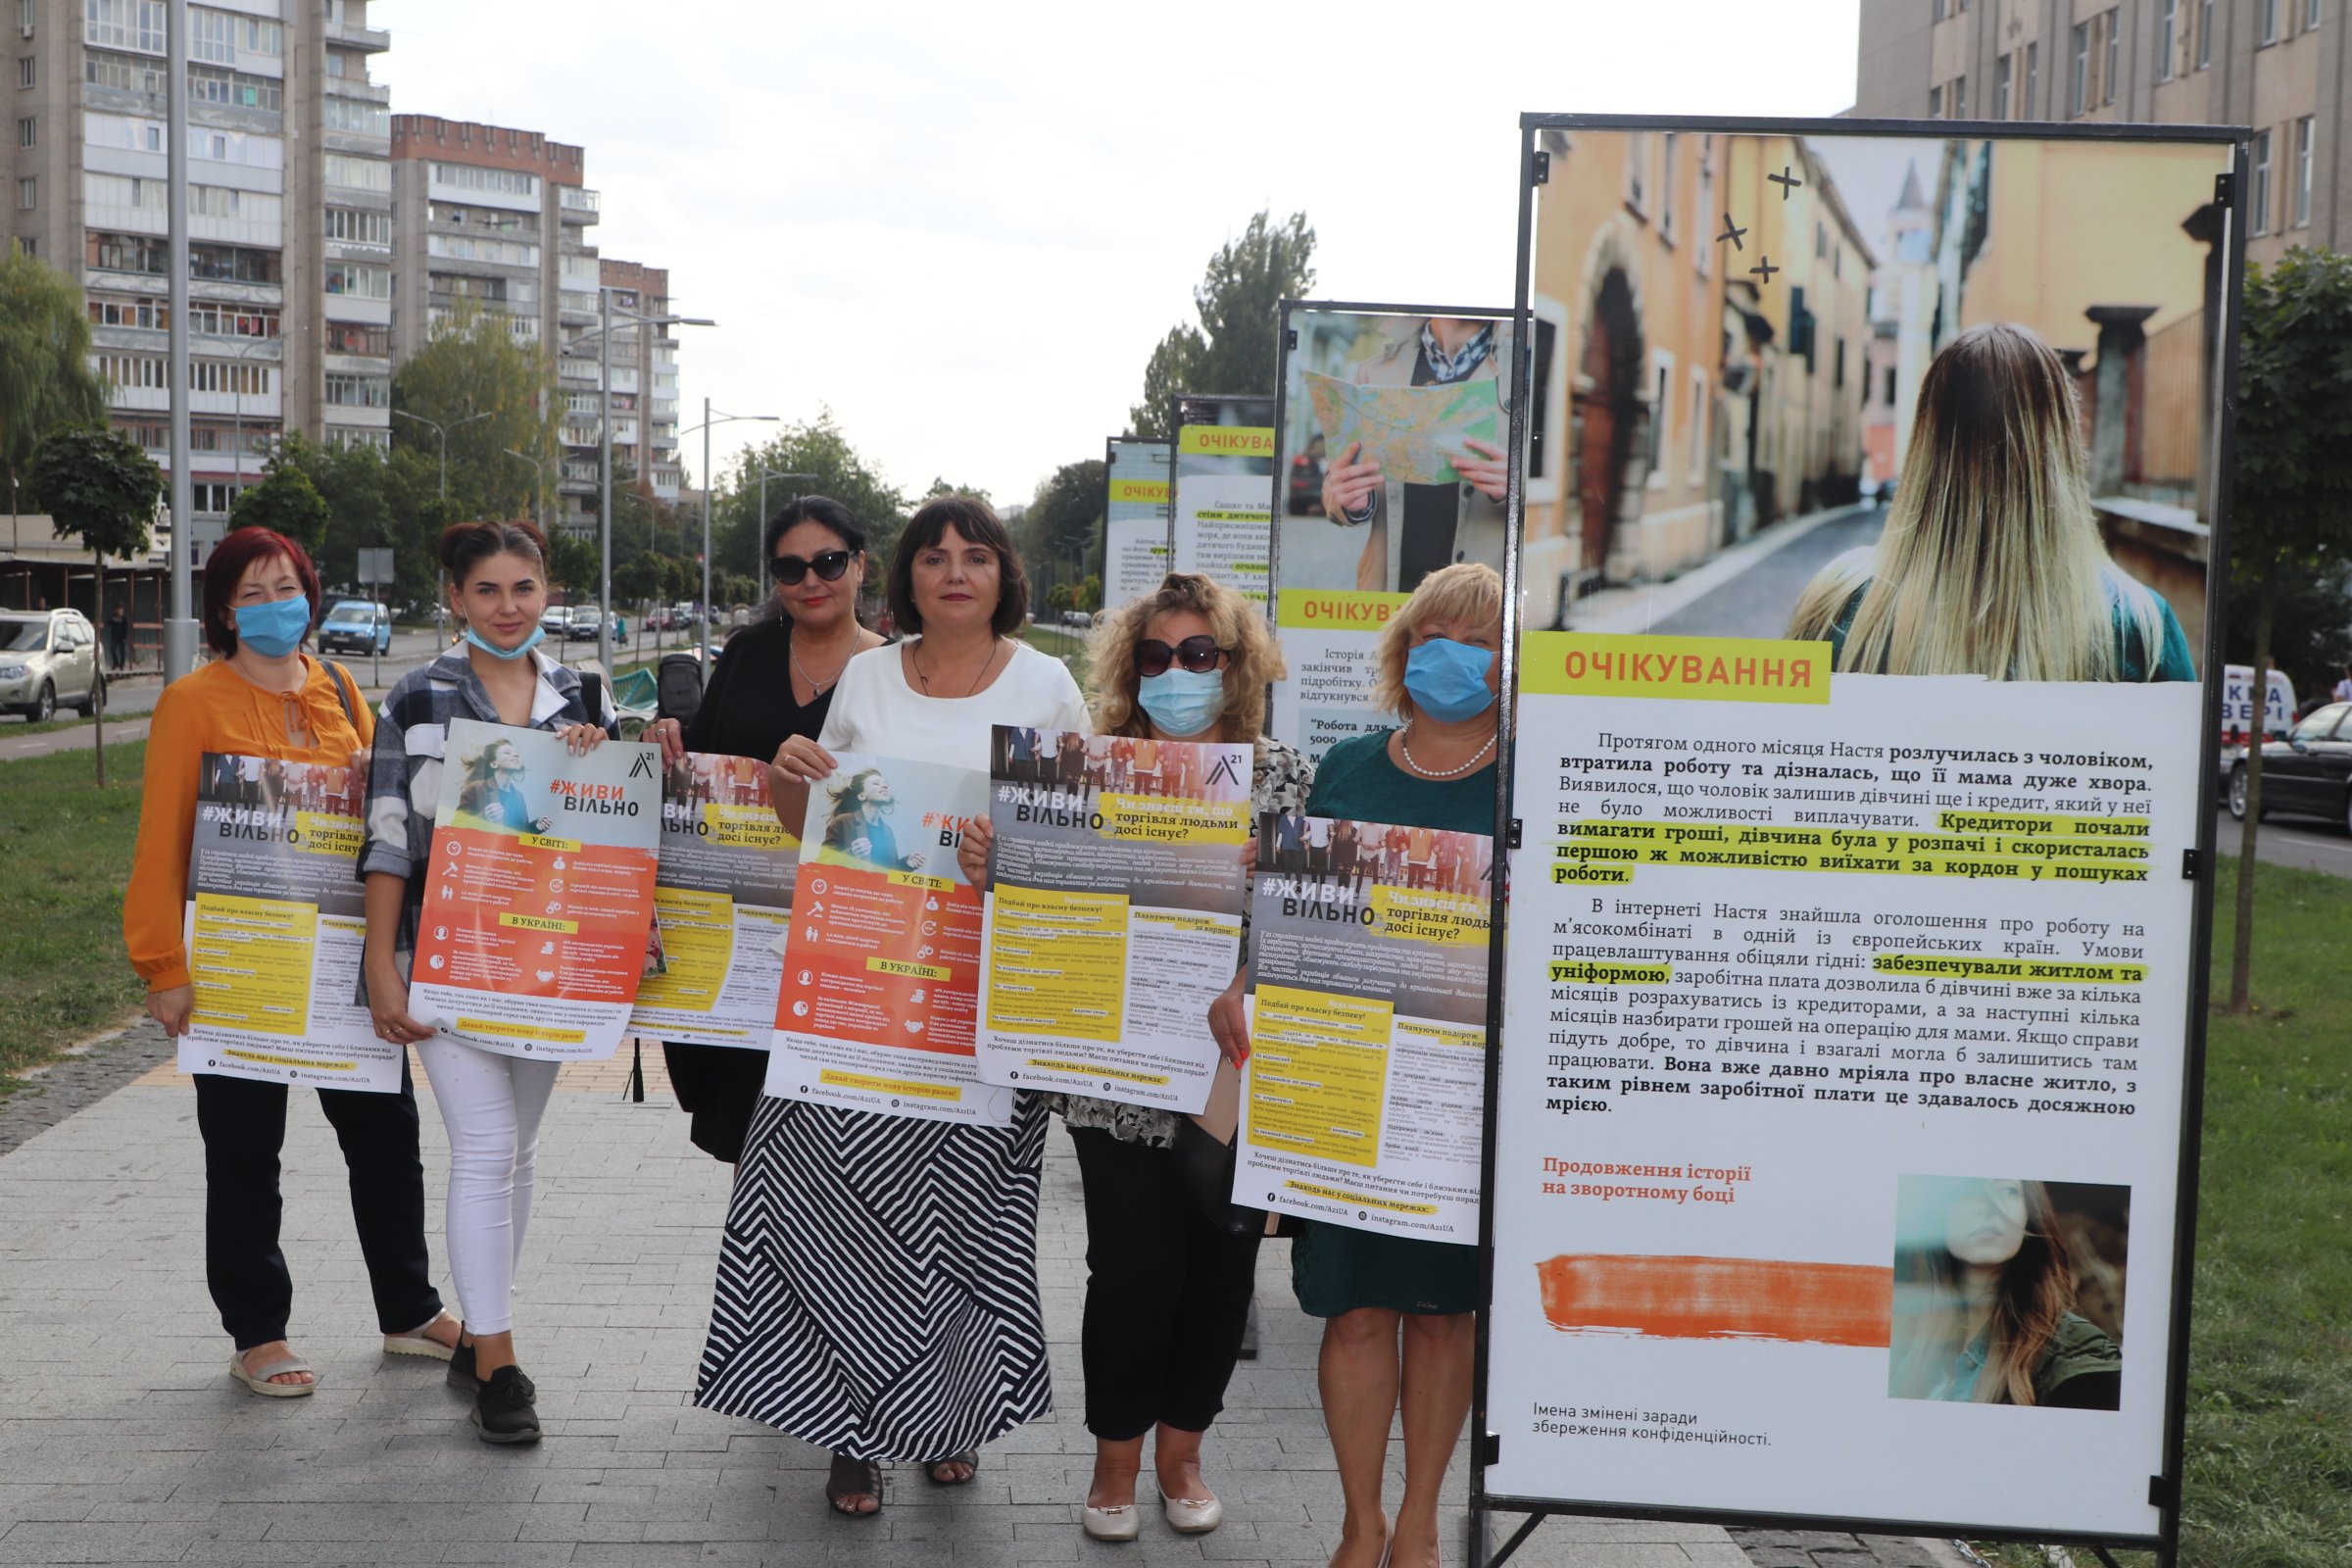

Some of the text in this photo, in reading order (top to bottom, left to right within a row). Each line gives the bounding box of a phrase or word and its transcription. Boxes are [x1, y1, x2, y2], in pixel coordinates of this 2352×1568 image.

[1199, 433, 1274, 450] ОЧІКУВА
[1303, 600, 1396, 621] ОЧІКУВ
[1325, 649, 1365, 662] Історія
[1300, 663, 1352, 674] закінчив
[1564, 650, 1811, 687] ОЧІКУВАННЯ
[1300, 675, 1365, 689] підробітку.
[1299, 690, 1369, 703] відгукнувся
[1309, 735, 1337, 745] 5000
[1598, 732, 2152, 770] Протягом одного місяця Настя розлучилась з чоловіком,
[1559, 757, 2151, 795] втратила роботу та дізналась, що її мама дуже хвора.
[549, 778, 624, 801] #ЖИВИ
[998, 784, 1084, 812] #ЖИВИ
[1559, 775, 2151, 816] Виявилося, що чоловік залишив дівчині ще і кредит, який у неї
[202, 806, 282, 828] #ЖИВИ
[564, 796, 639, 817] ВІЛЬНО
[1016, 804, 1104, 830] ВІЛЬНО
[1558, 798, 2149, 836] не було можливості виплачувати. Кредитори почали
[717, 821, 771, 833] торгівля
[1114, 812, 1239, 830] торгівля людьми
[219, 822, 299, 845] ВІЛЬНО
[309, 828, 360, 843] торгівля
[531, 836, 568, 850] У СВІТІ:
[716, 832, 781, 847] досі існує?
[1113, 825, 1189, 840] досі існує?
[1556, 823, 2148, 859] вимагати гроші, дівчина була у розпачі і скористалась
[308, 838, 332, 850] досі
[1554, 863, 1629, 883] роботи.
[1555, 846, 2148, 884] першою ж можливістю виїхати за кордон у пошуках
[903, 874, 909, 883] У
[1261, 877, 1355, 906] #ЖИВИ
[1282, 898, 1375, 926] ВІЛЬНО
[1387, 906, 1491, 930] торгівля людь
[1591, 898, 2143, 939] В інтернеті Настя знайшла оголошення про роботу на
[512, 916, 565, 931] В УКРАЇНІ:
[1385, 921, 1460, 940] досі існує?
[880, 960, 938, 978] В УКРАЇНІ:
[1260, 999, 1290, 1010] Подбай
[1291, 1004, 1304, 1013] про
[1545, 1075, 2134, 1114] таким рівнем заробітної плати це здавалось досяжною
[1545, 1095, 1611, 1114] мрією.
[1543, 1156, 1750, 1185] Продовження історії
[1289, 1180, 1321, 1195] Знаходь
[1542, 1182, 1735, 1204] на зворотному боці
[1534, 1401, 1696, 1426] Імена змінені заради
[1532, 1419, 1772, 1446] збереження конфіденційності.
